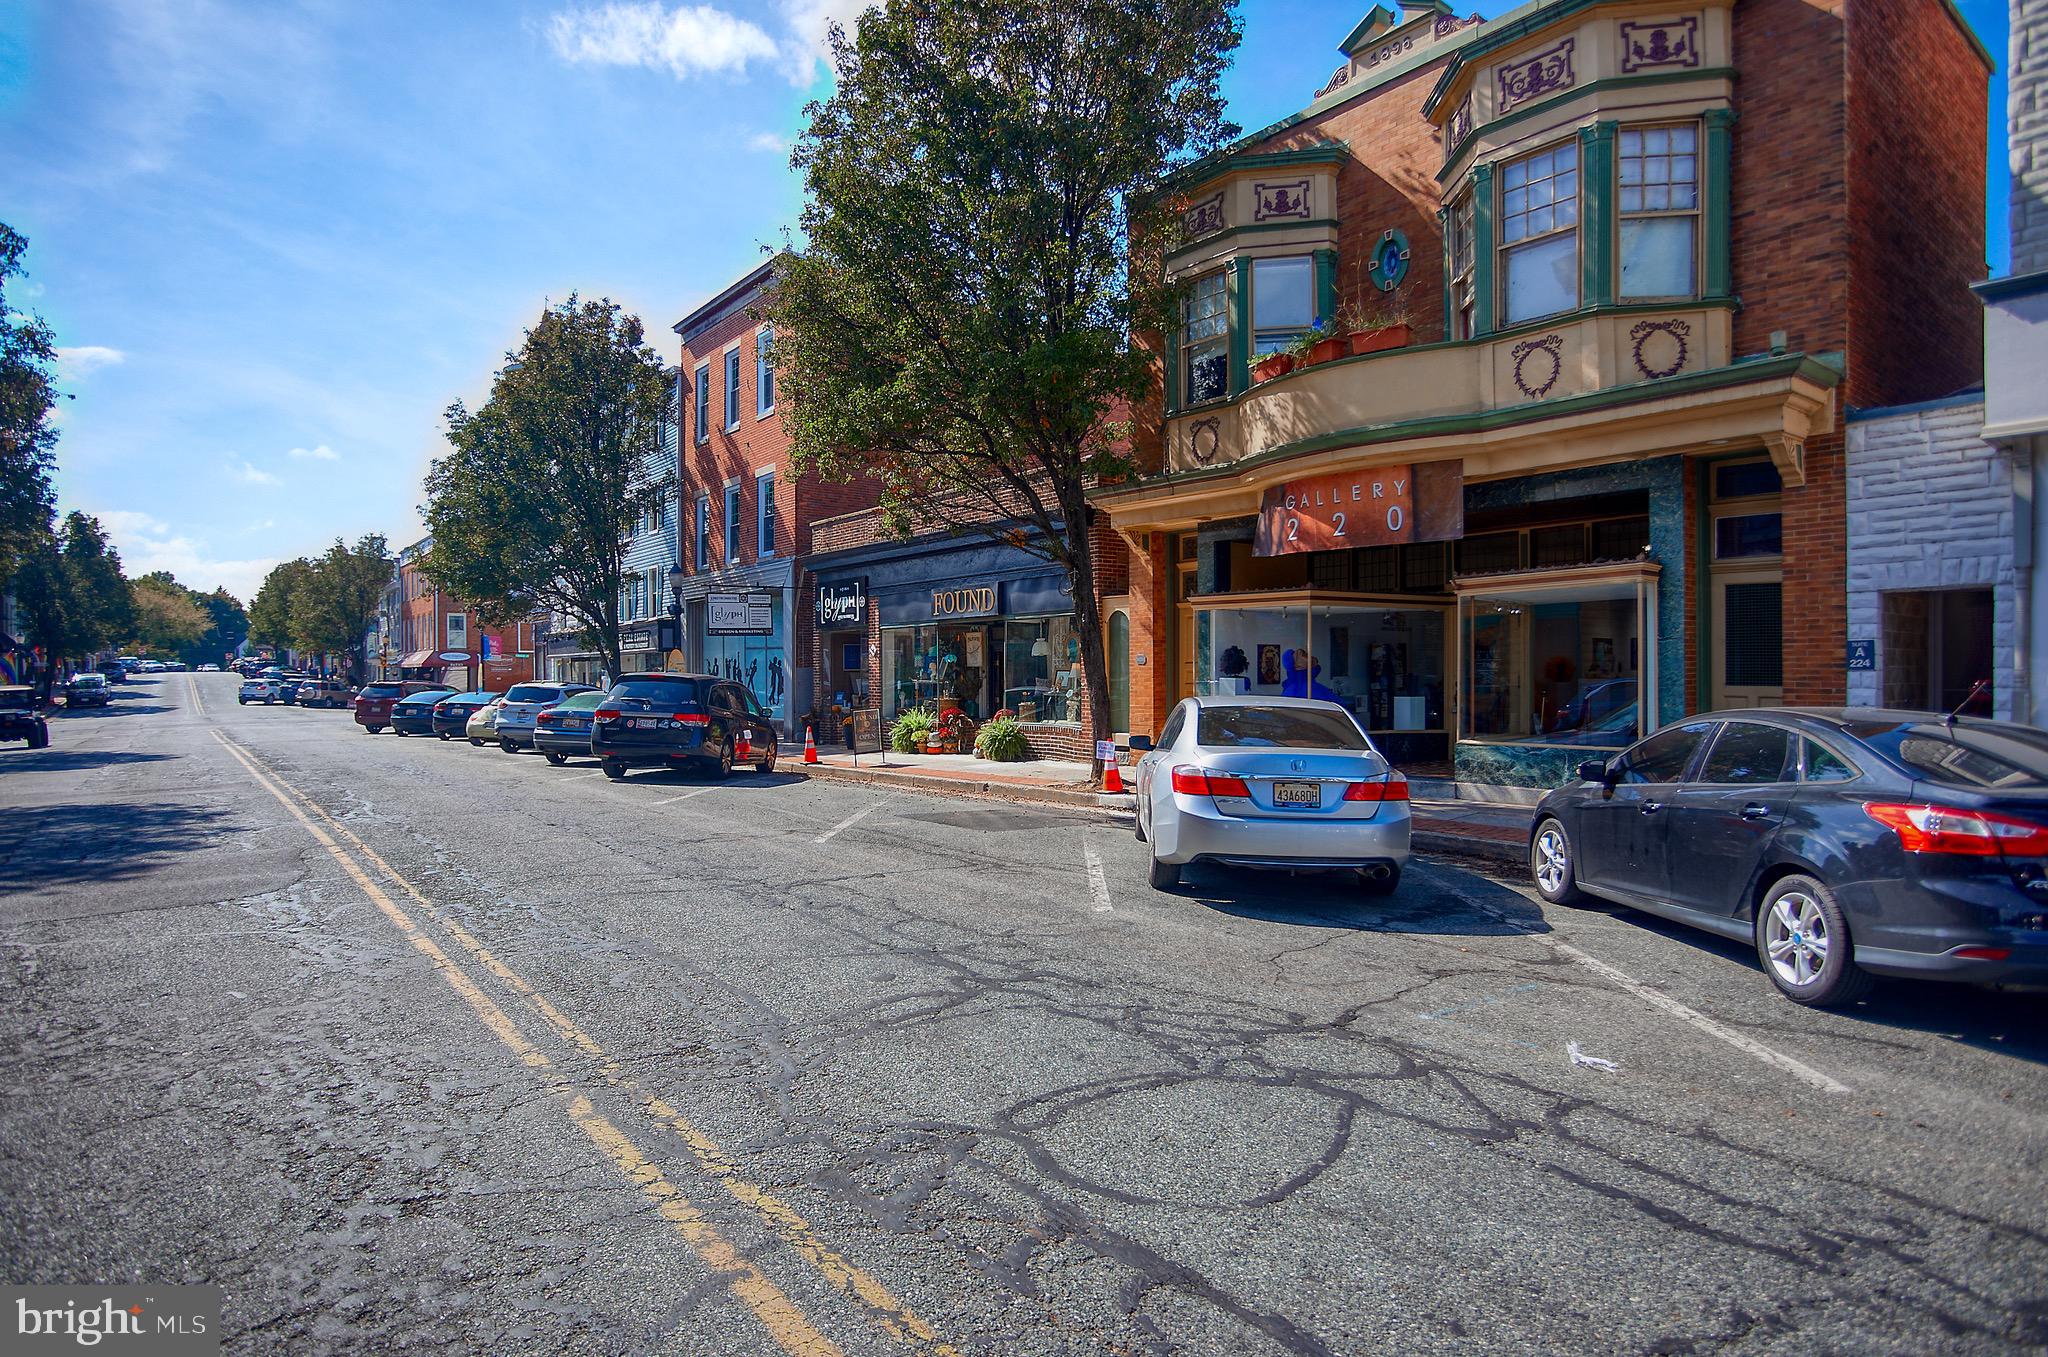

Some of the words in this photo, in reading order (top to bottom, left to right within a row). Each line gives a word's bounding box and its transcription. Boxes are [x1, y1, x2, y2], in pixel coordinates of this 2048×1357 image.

[1370, 36, 1411, 66] 1896
[1285, 480, 1405, 510] GALLERY
[1287, 518, 1299, 541] 2
[1332, 512, 1346, 537] 2
[1387, 505, 1403, 531] 0
[933, 588, 995, 615] FOUND
[1849, 659, 1870, 668] 224
[1855, 647, 1865, 656] A
